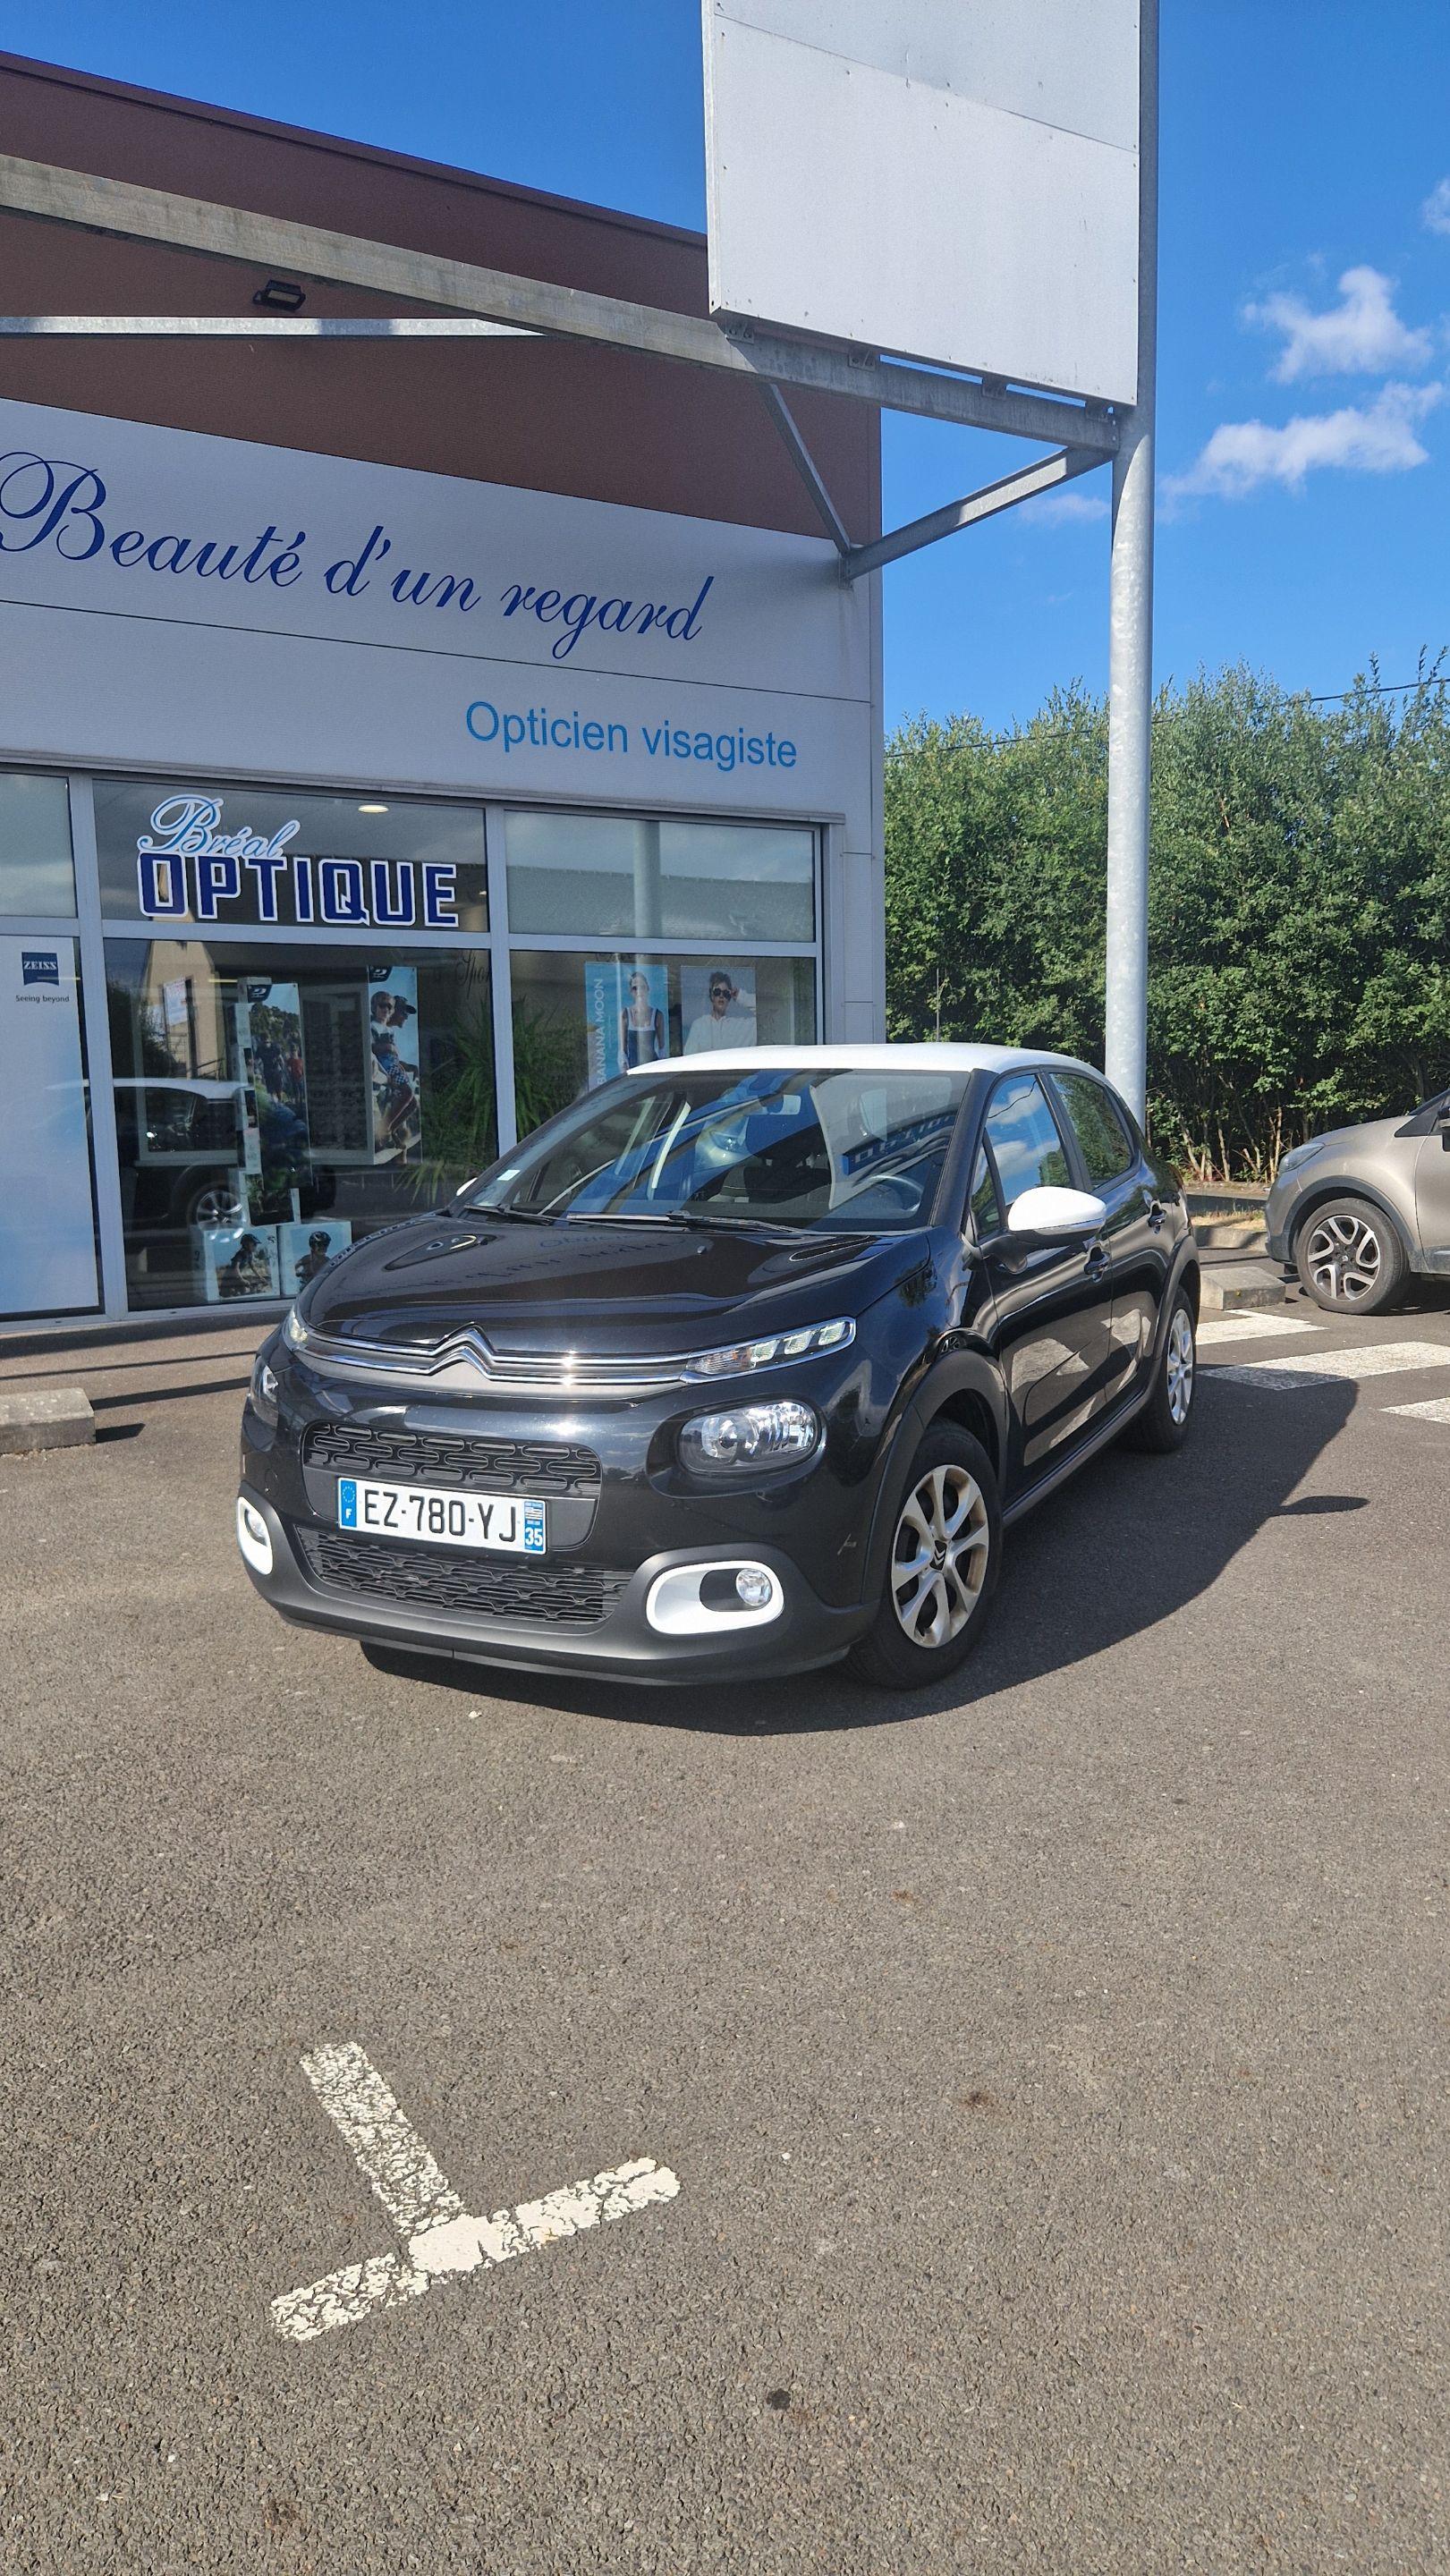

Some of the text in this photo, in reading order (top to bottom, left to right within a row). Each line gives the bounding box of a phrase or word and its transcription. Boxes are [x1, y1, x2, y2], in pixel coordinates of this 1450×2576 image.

[0, 452, 714, 660] Beauté d'un regard
[466, 700, 797, 772] Opticien visagiste
[138, 794, 300, 859] Bréal
[139, 852, 459, 927] OPTIQUE
[23, 961, 57, 970] ZEISS
[15, 994, 70, 1004] Seeing beyond
[593, 979, 605, 1021] MOON
[345, 1508, 352, 1520] F
[364, 1488, 516, 1543] EZ-780-YJ
[524, 1526, 544, 1546] 35
